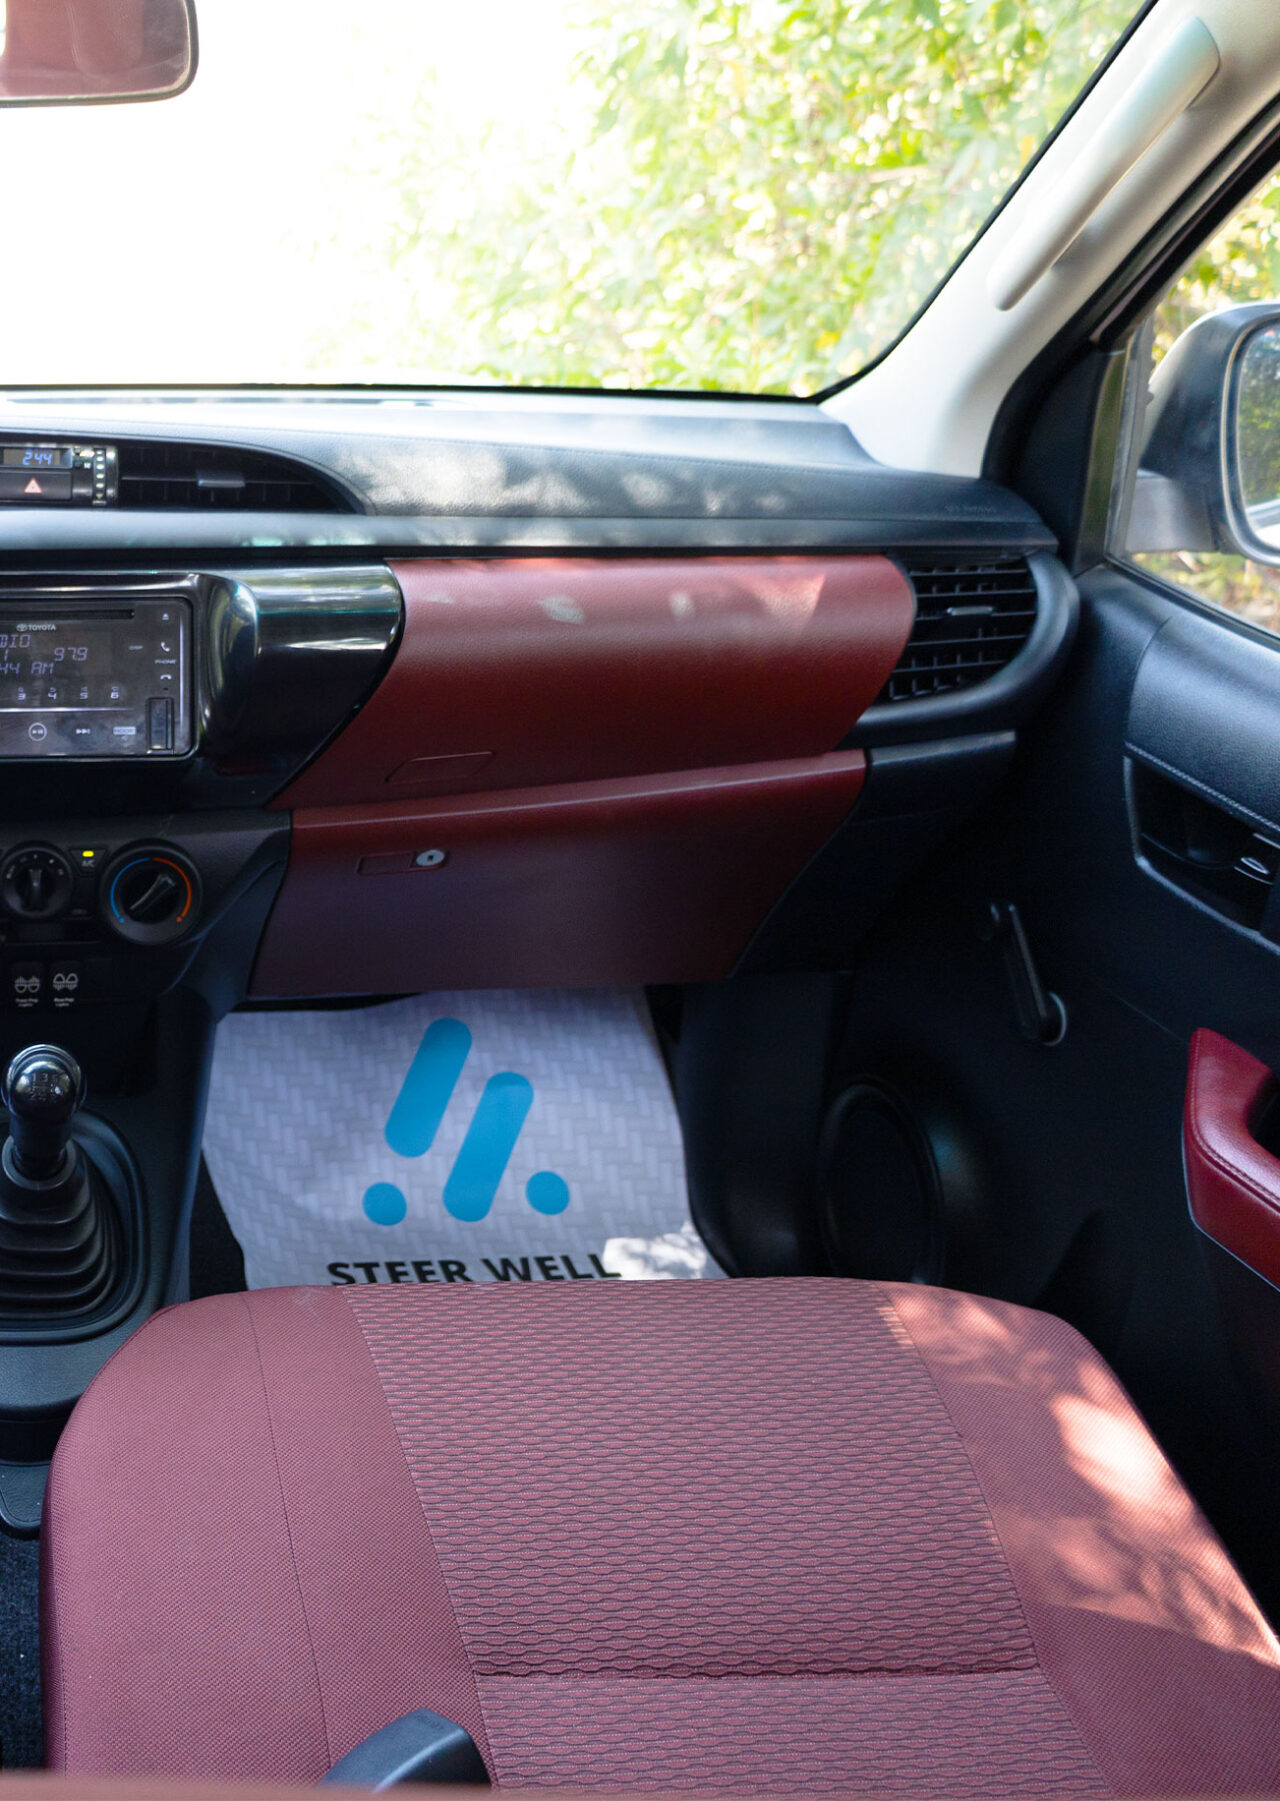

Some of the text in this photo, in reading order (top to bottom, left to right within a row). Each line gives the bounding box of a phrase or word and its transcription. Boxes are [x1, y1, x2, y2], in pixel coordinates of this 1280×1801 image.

[28, 623, 56, 631] TOYOTA
[30, 662, 54, 675] AM
[326, 1253, 623, 1285] STEER WELL
